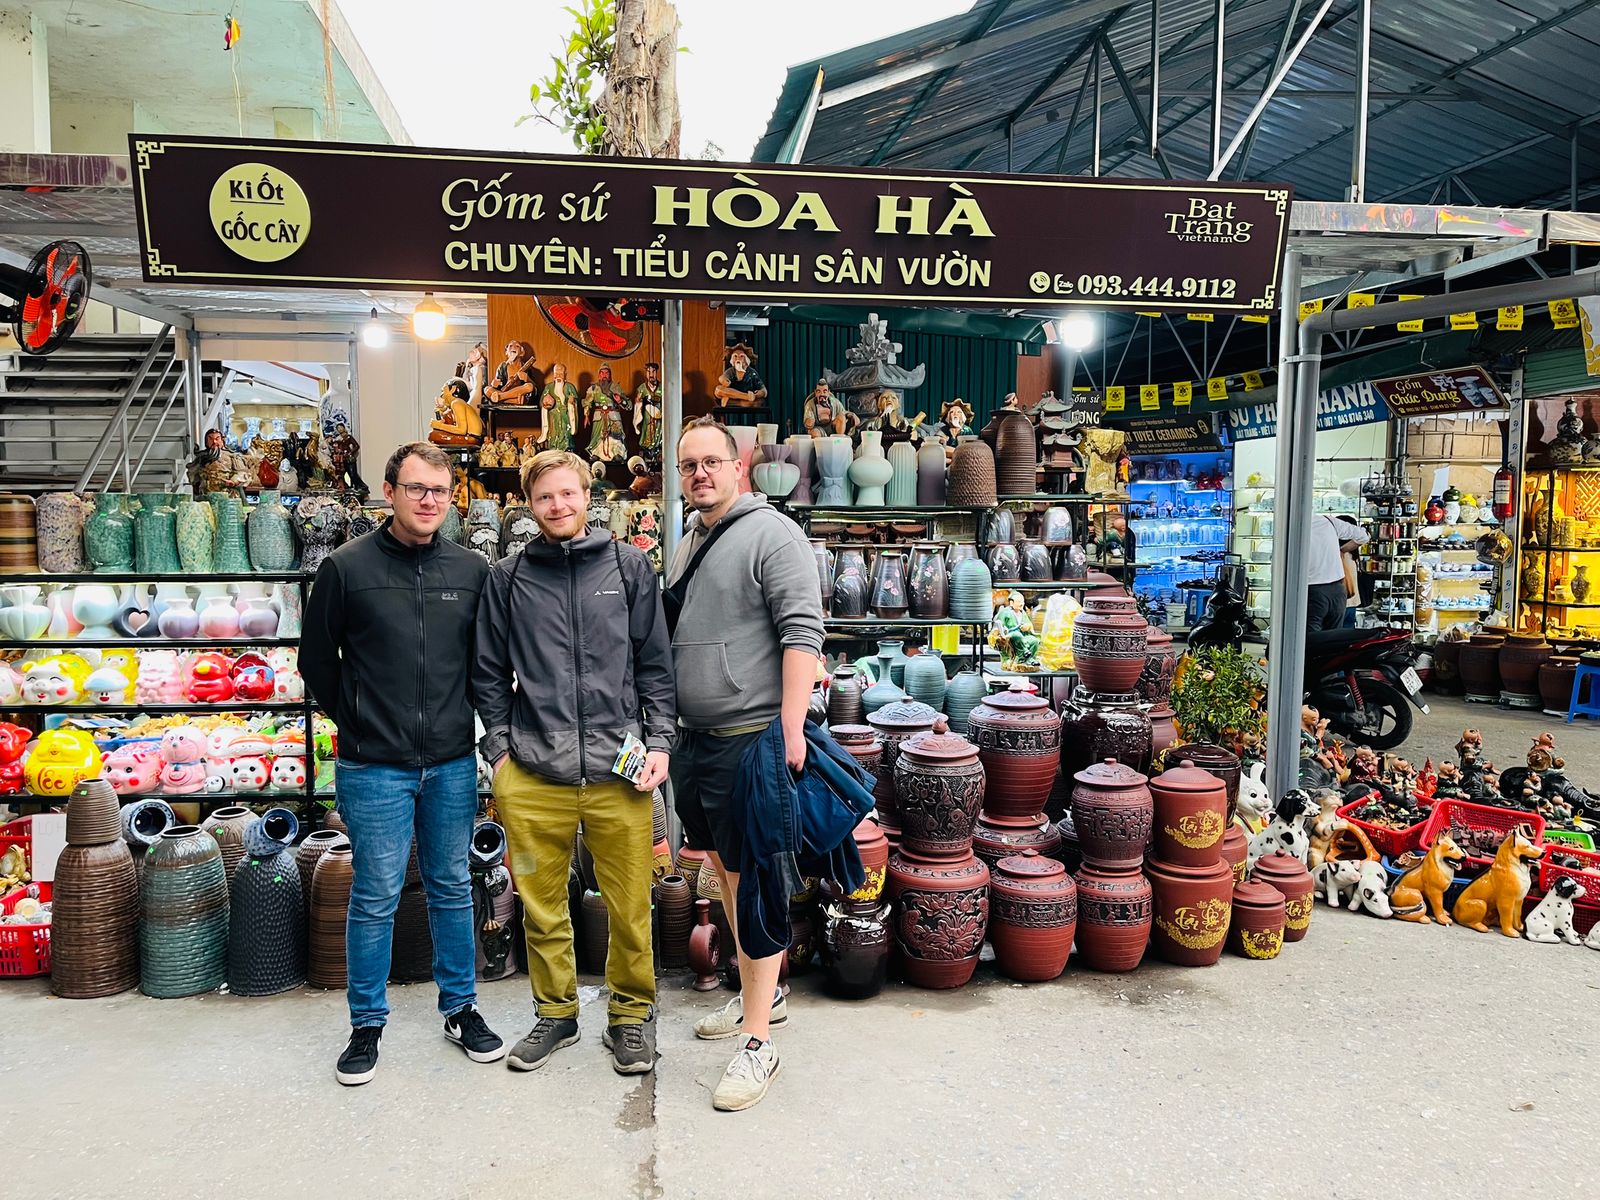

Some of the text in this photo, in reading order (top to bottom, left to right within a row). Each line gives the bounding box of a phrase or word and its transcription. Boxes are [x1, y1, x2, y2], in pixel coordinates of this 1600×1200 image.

[229, 172, 284, 200] Ki Ốt
[441, 172, 996, 237] Gốm sứ HÒA HÀ
[221, 211, 300, 243] GỐC CÂY
[444, 234, 991, 287] CHUYÊN: TIỂU CẢNH SÂN VƯỜN
[1077, 274, 1237, 298] 093.444.9112
[1395, 379, 1423, 394] Gốm
[1155, 427, 1198, 442] CERAMICS
